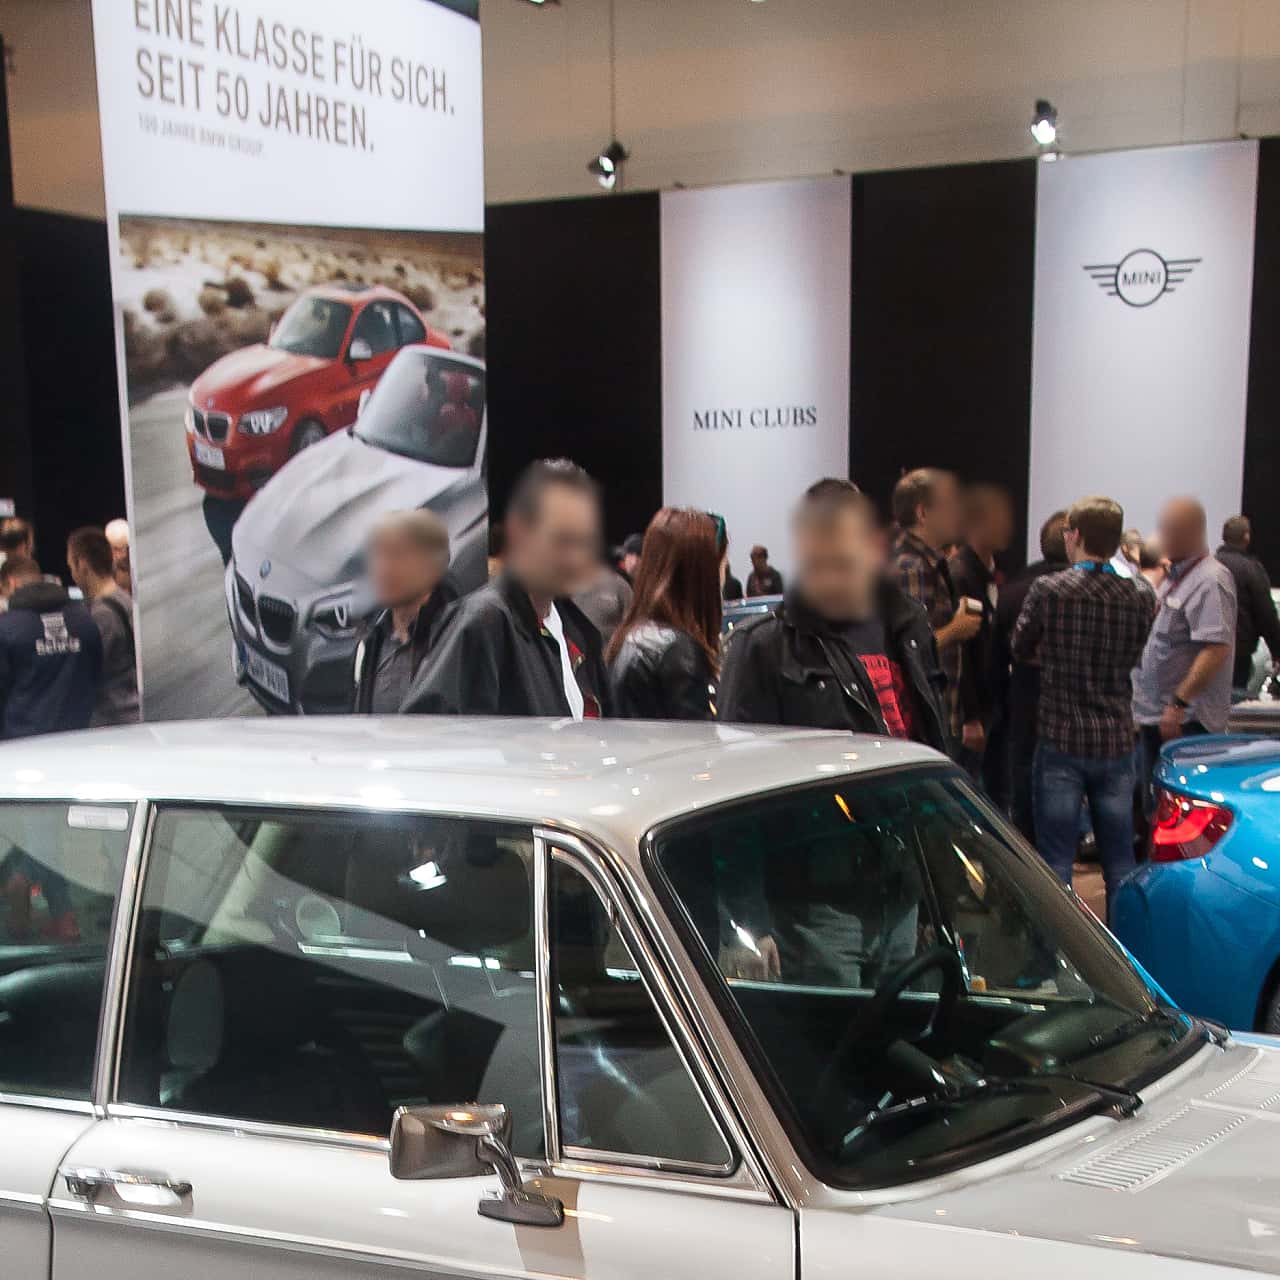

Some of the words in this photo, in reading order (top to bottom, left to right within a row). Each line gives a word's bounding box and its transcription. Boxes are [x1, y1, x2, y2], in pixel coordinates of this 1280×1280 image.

[134, 0, 205, 47] EINE
[214, 3, 325, 81] KLASSE
[333, 34, 382, 97] FÜR
[390, 55, 456, 116] SICH.
[136, 48, 205, 112] SEIT
[216, 69, 249, 122] 50
[258, 80, 376, 153] JAHREN.
[1122, 271, 1162, 287] MINI
[693, 409, 742, 431] MINI
[749, 405, 817, 428] CLUBS
